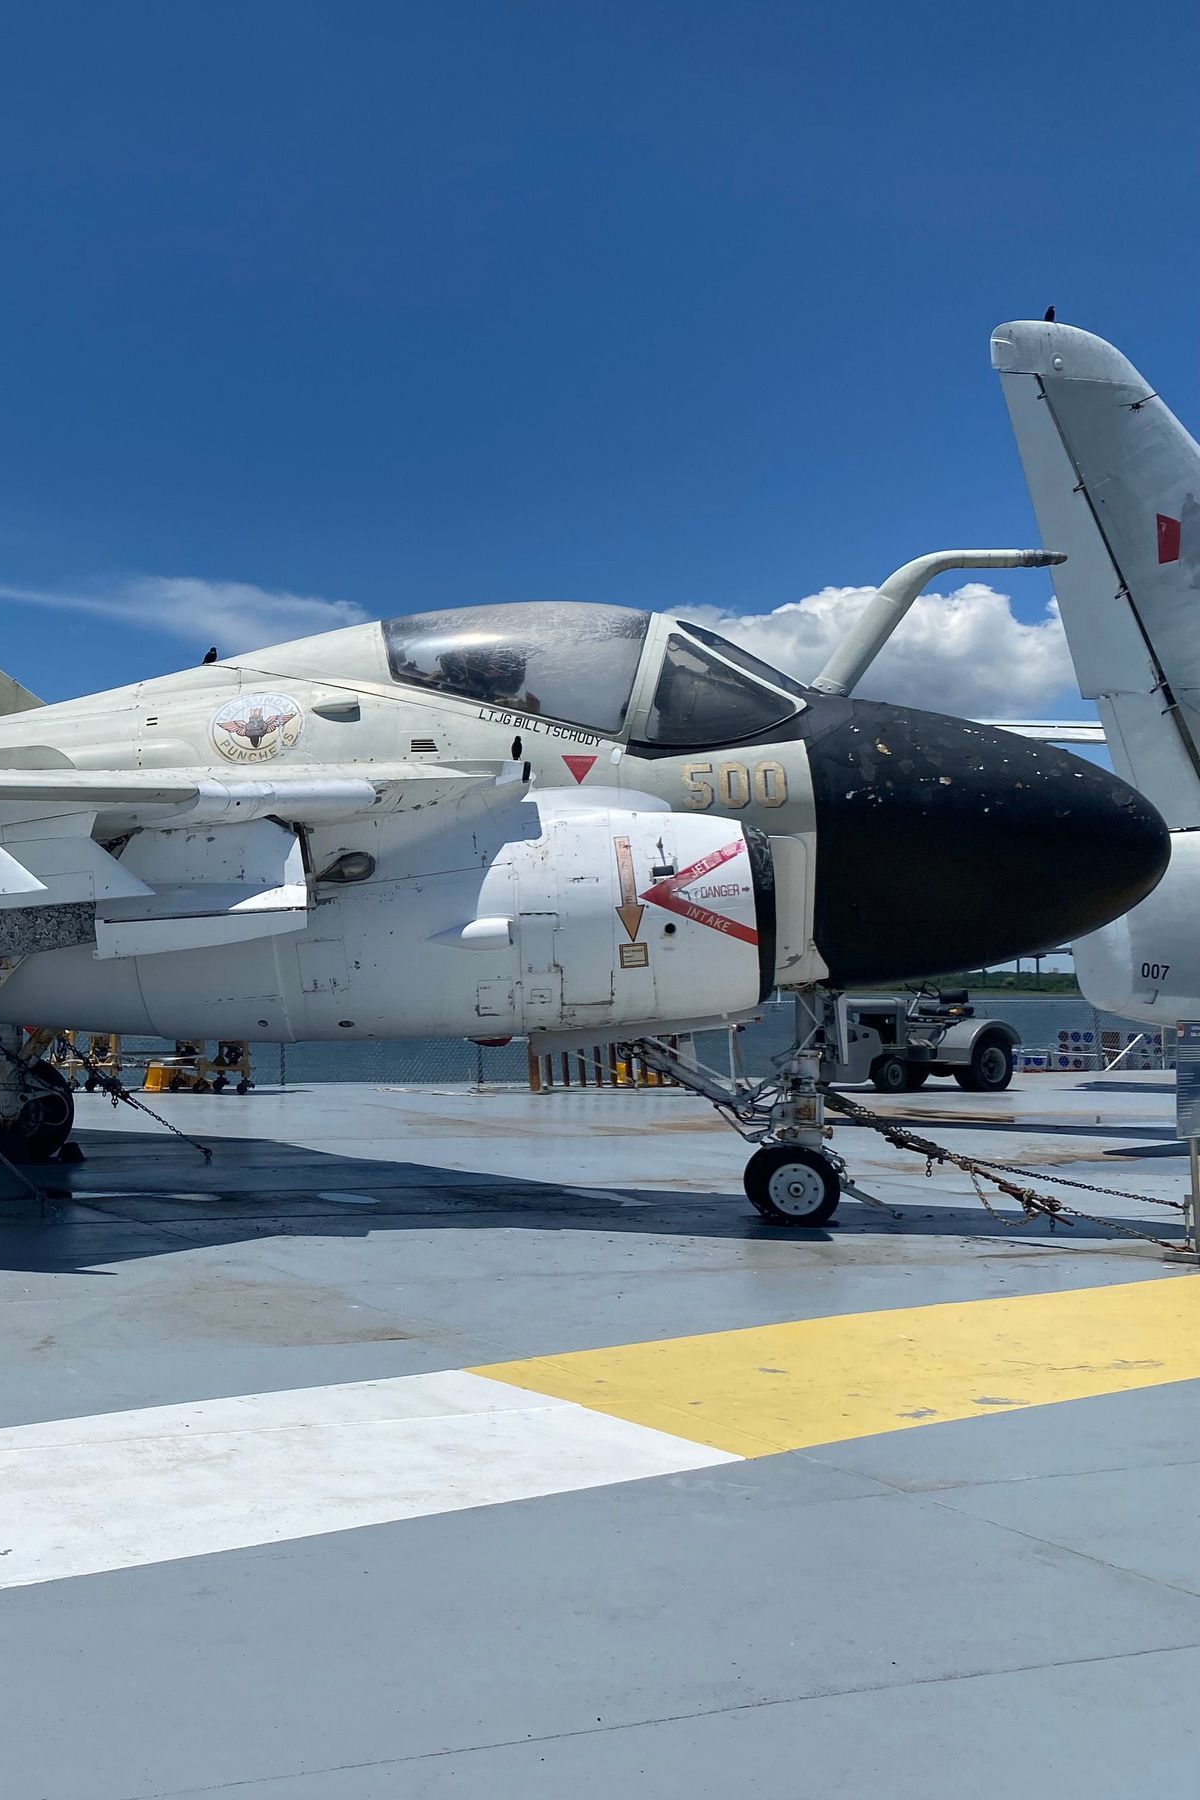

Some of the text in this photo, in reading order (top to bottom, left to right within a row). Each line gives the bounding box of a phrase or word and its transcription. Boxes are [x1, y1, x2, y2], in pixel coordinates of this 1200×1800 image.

[478, 708, 602, 747] LTJG BILL TSCHUDY
[220, 732, 294, 761] PUNCHES
[680, 760, 789, 810] 500
[690, 860, 712, 878] JET
[701, 884, 740, 899] DANGER
[686, 906, 731, 932] INTAKE
[1141, 962, 1170, 981] 007
